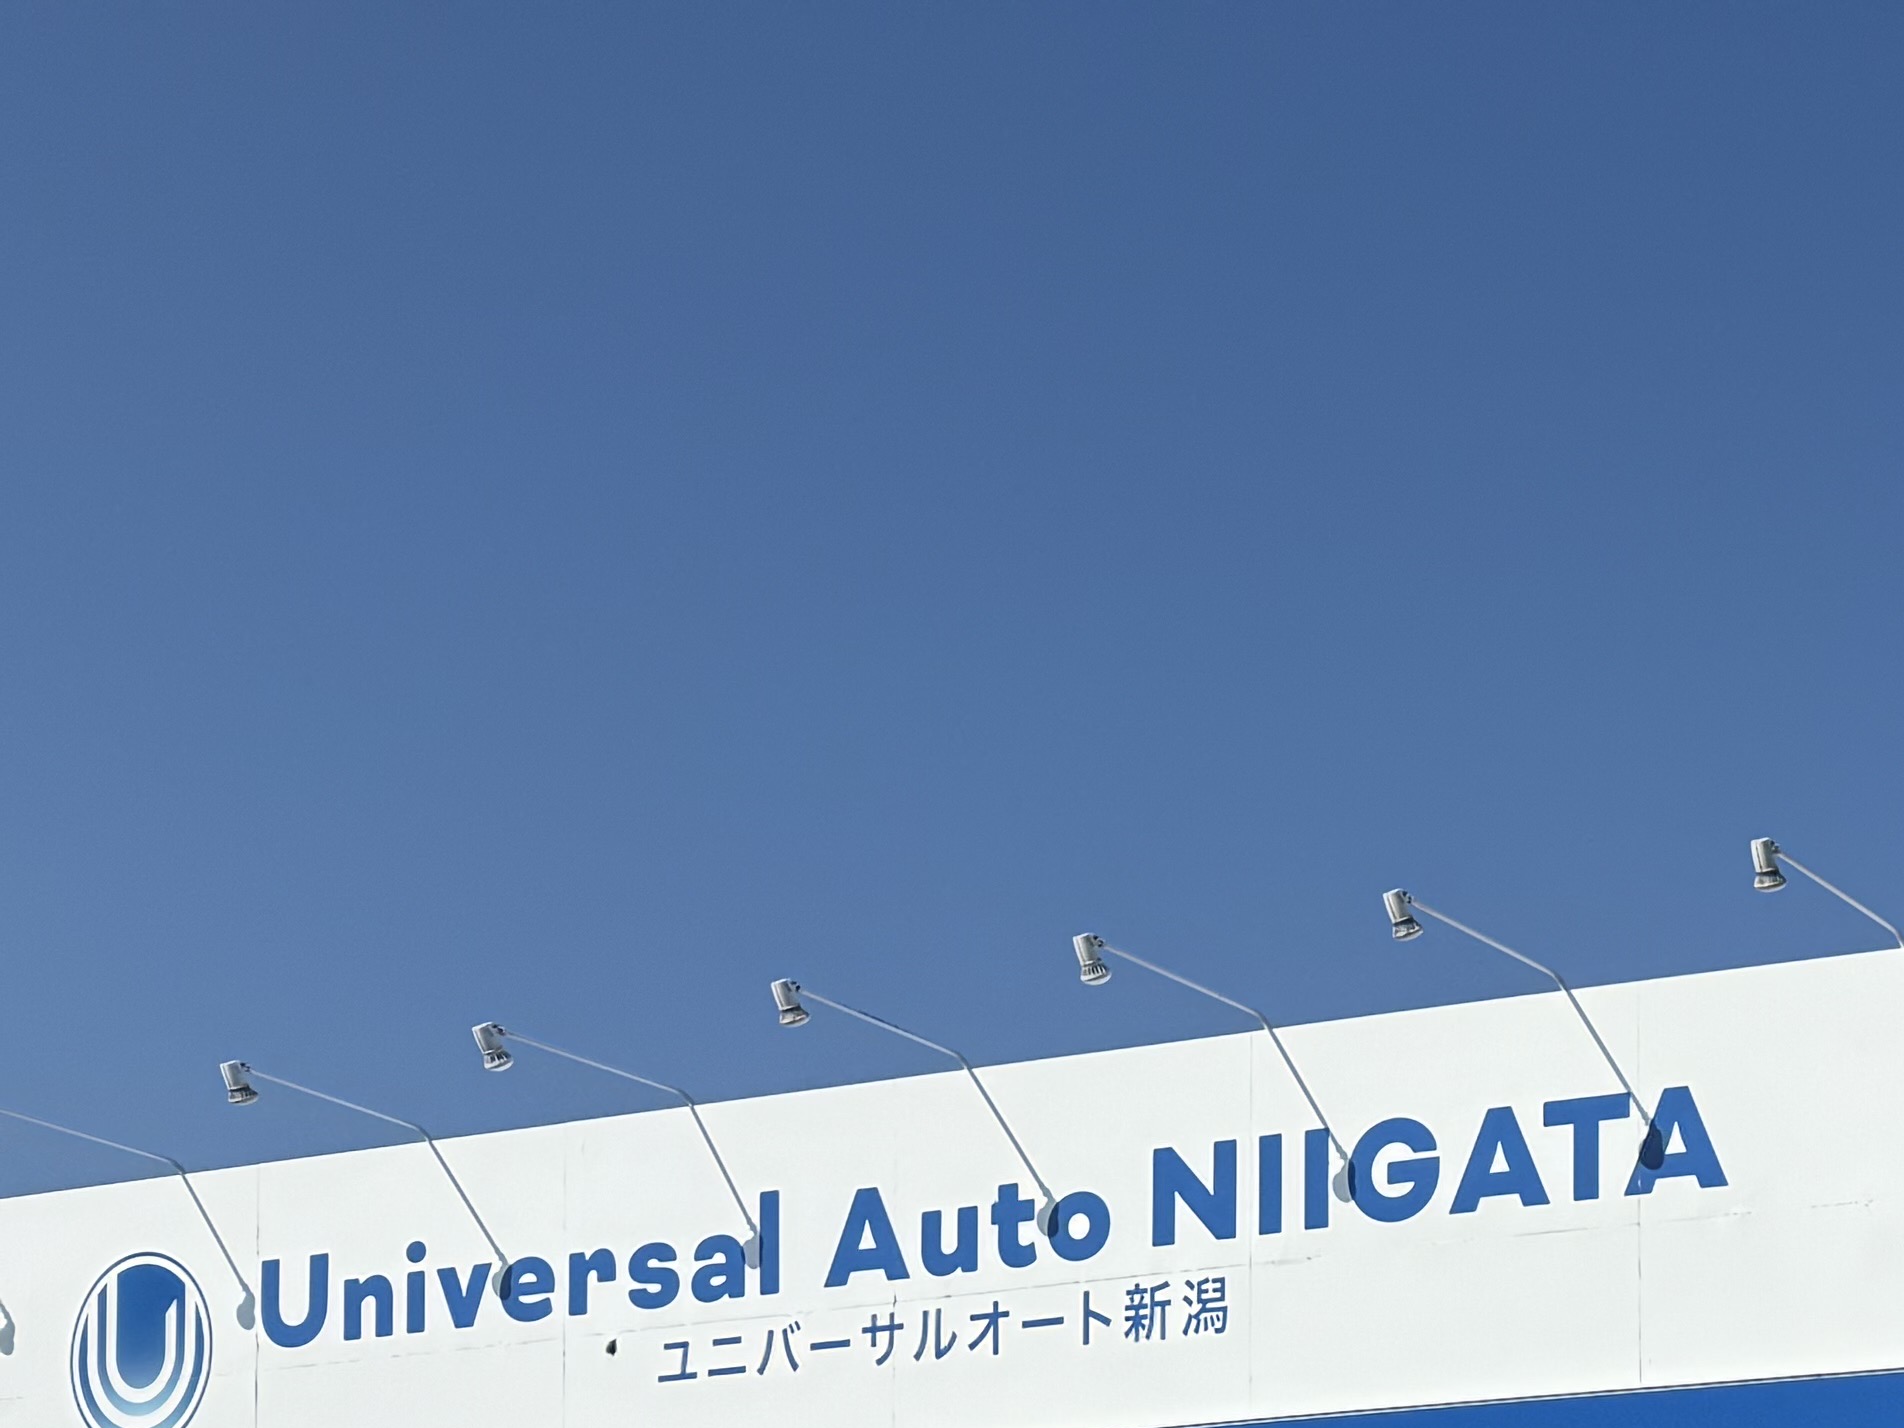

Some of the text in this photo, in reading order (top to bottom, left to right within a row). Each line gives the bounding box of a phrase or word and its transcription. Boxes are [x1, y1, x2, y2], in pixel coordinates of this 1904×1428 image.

[261, 1087, 1729, 1348] Universal Auto NIIGATA
[657, 1280, 1229, 1384] ユニバーサルオート新潟
